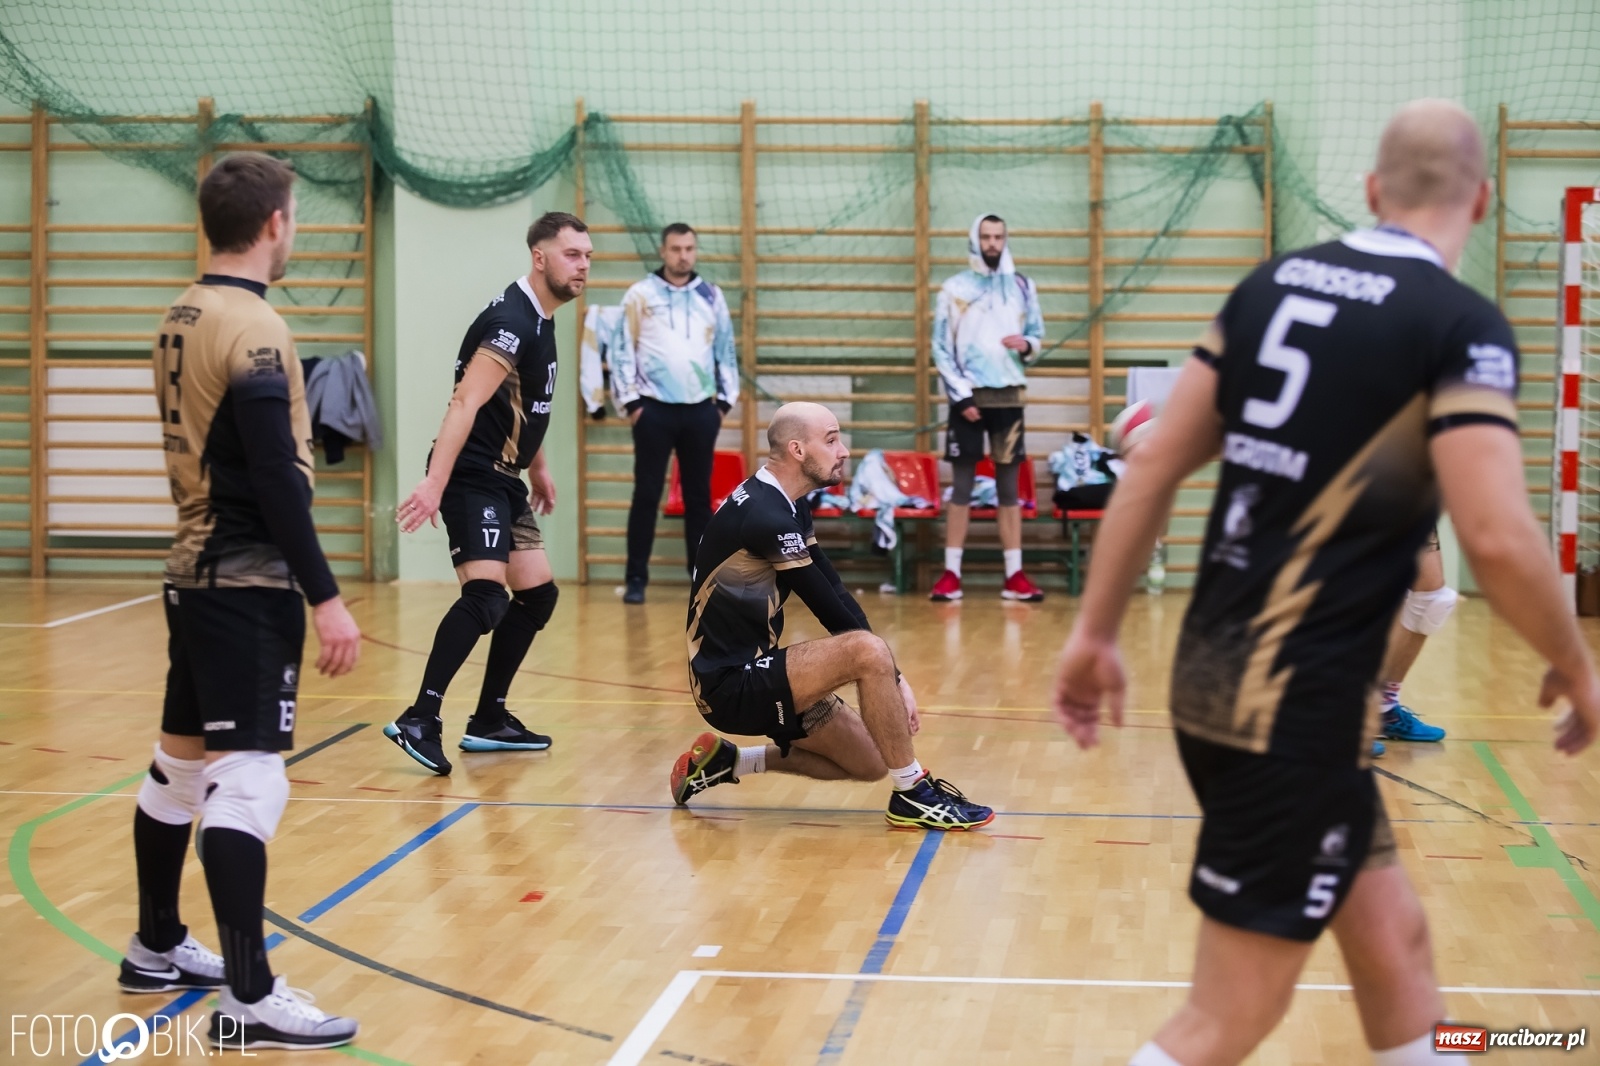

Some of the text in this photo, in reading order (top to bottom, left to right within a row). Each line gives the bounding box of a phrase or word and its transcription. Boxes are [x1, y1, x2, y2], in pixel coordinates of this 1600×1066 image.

[1242, 294, 1338, 429] 5
[482, 528, 500, 548] 17
[1303, 873, 1339, 918] 5
